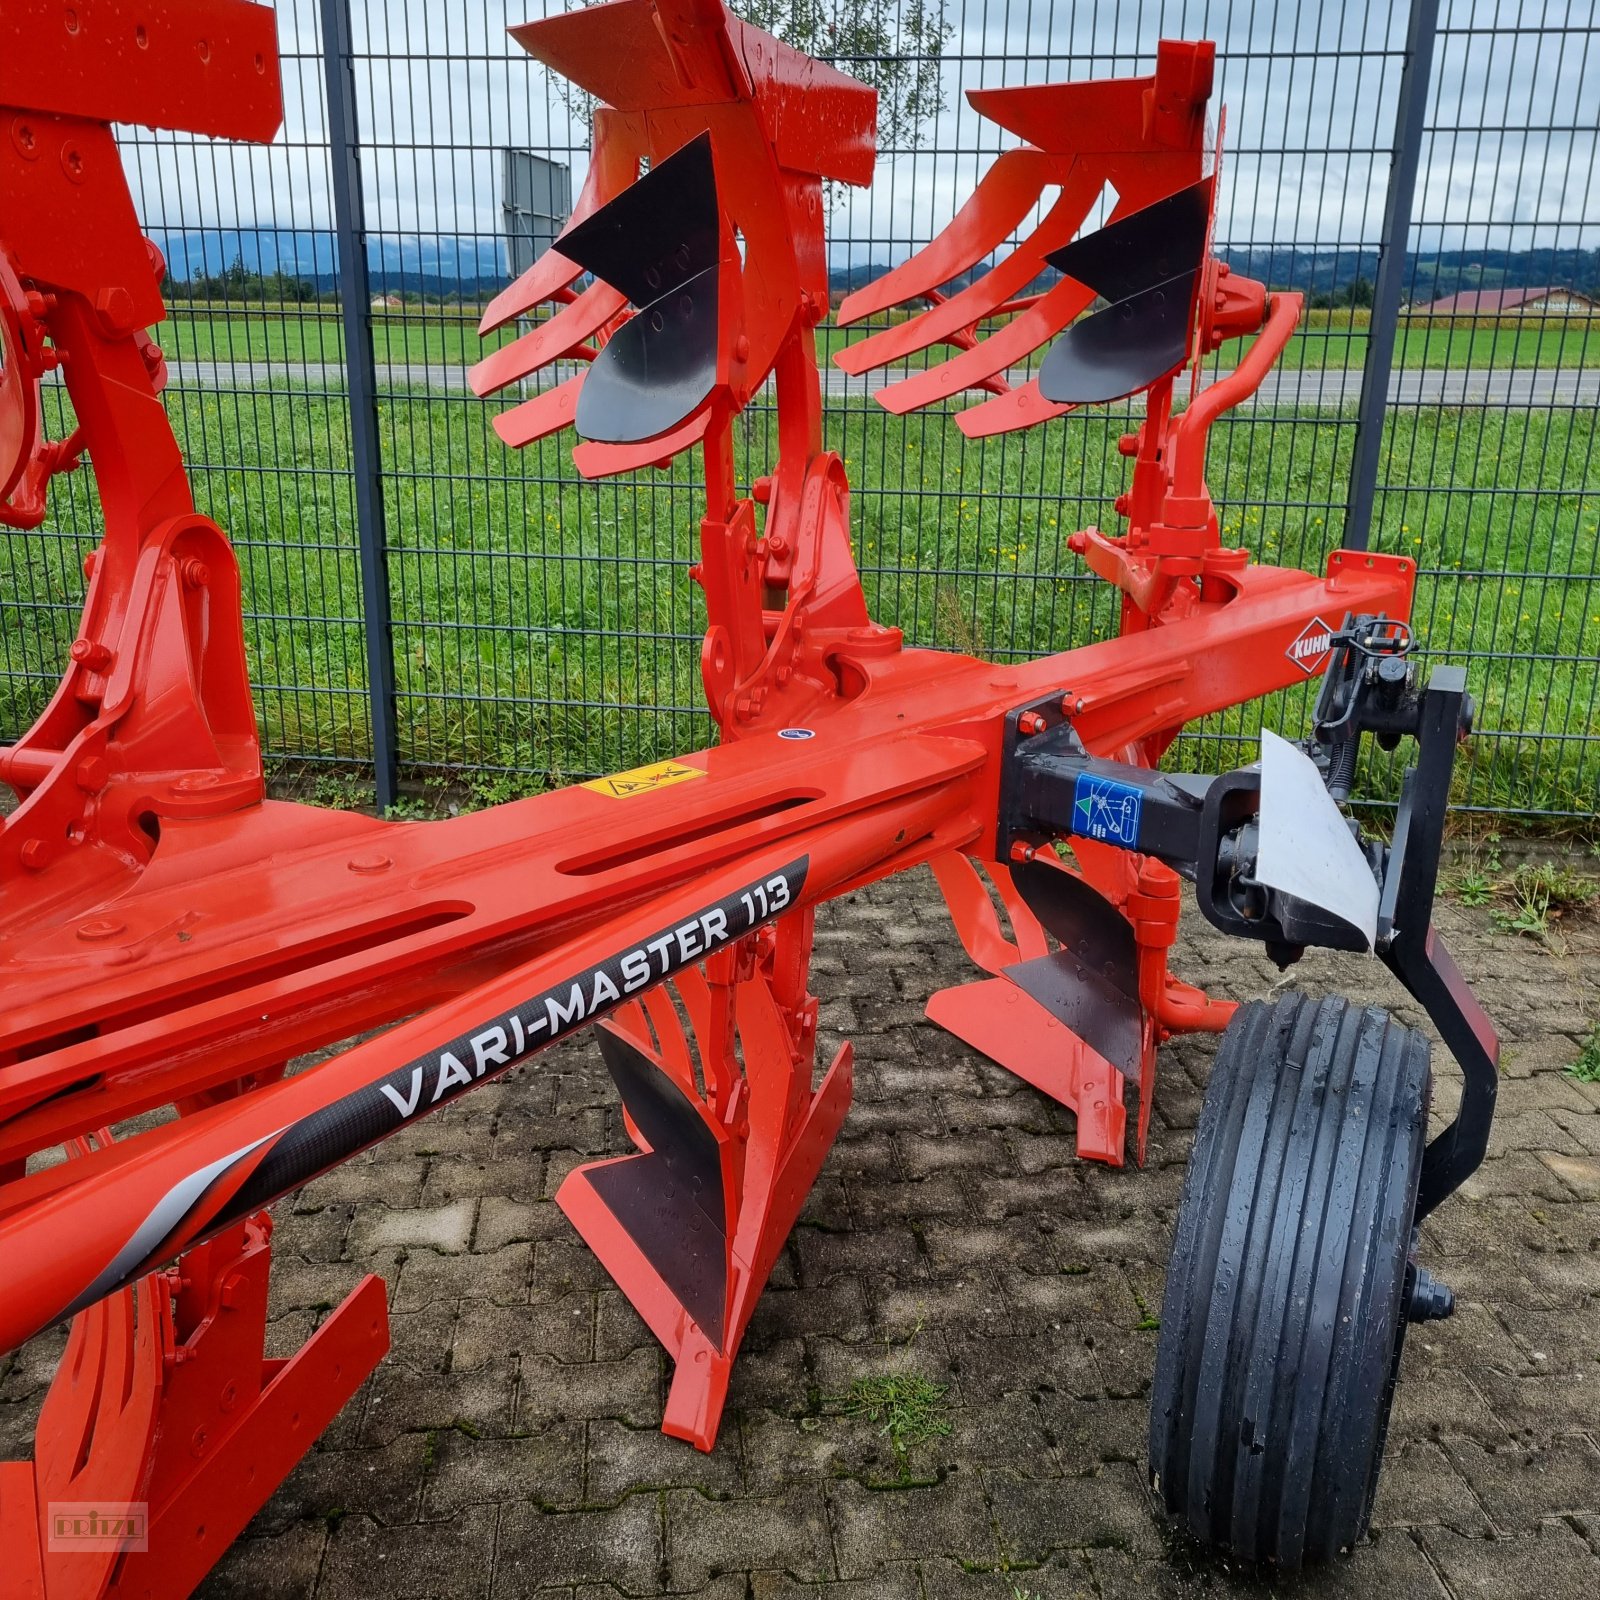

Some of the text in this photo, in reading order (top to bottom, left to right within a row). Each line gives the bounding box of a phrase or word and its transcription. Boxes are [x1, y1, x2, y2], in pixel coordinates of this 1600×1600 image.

[1294, 633, 1331, 659] KUHN
[379, 874, 791, 1119] VARI-MASTER 113
